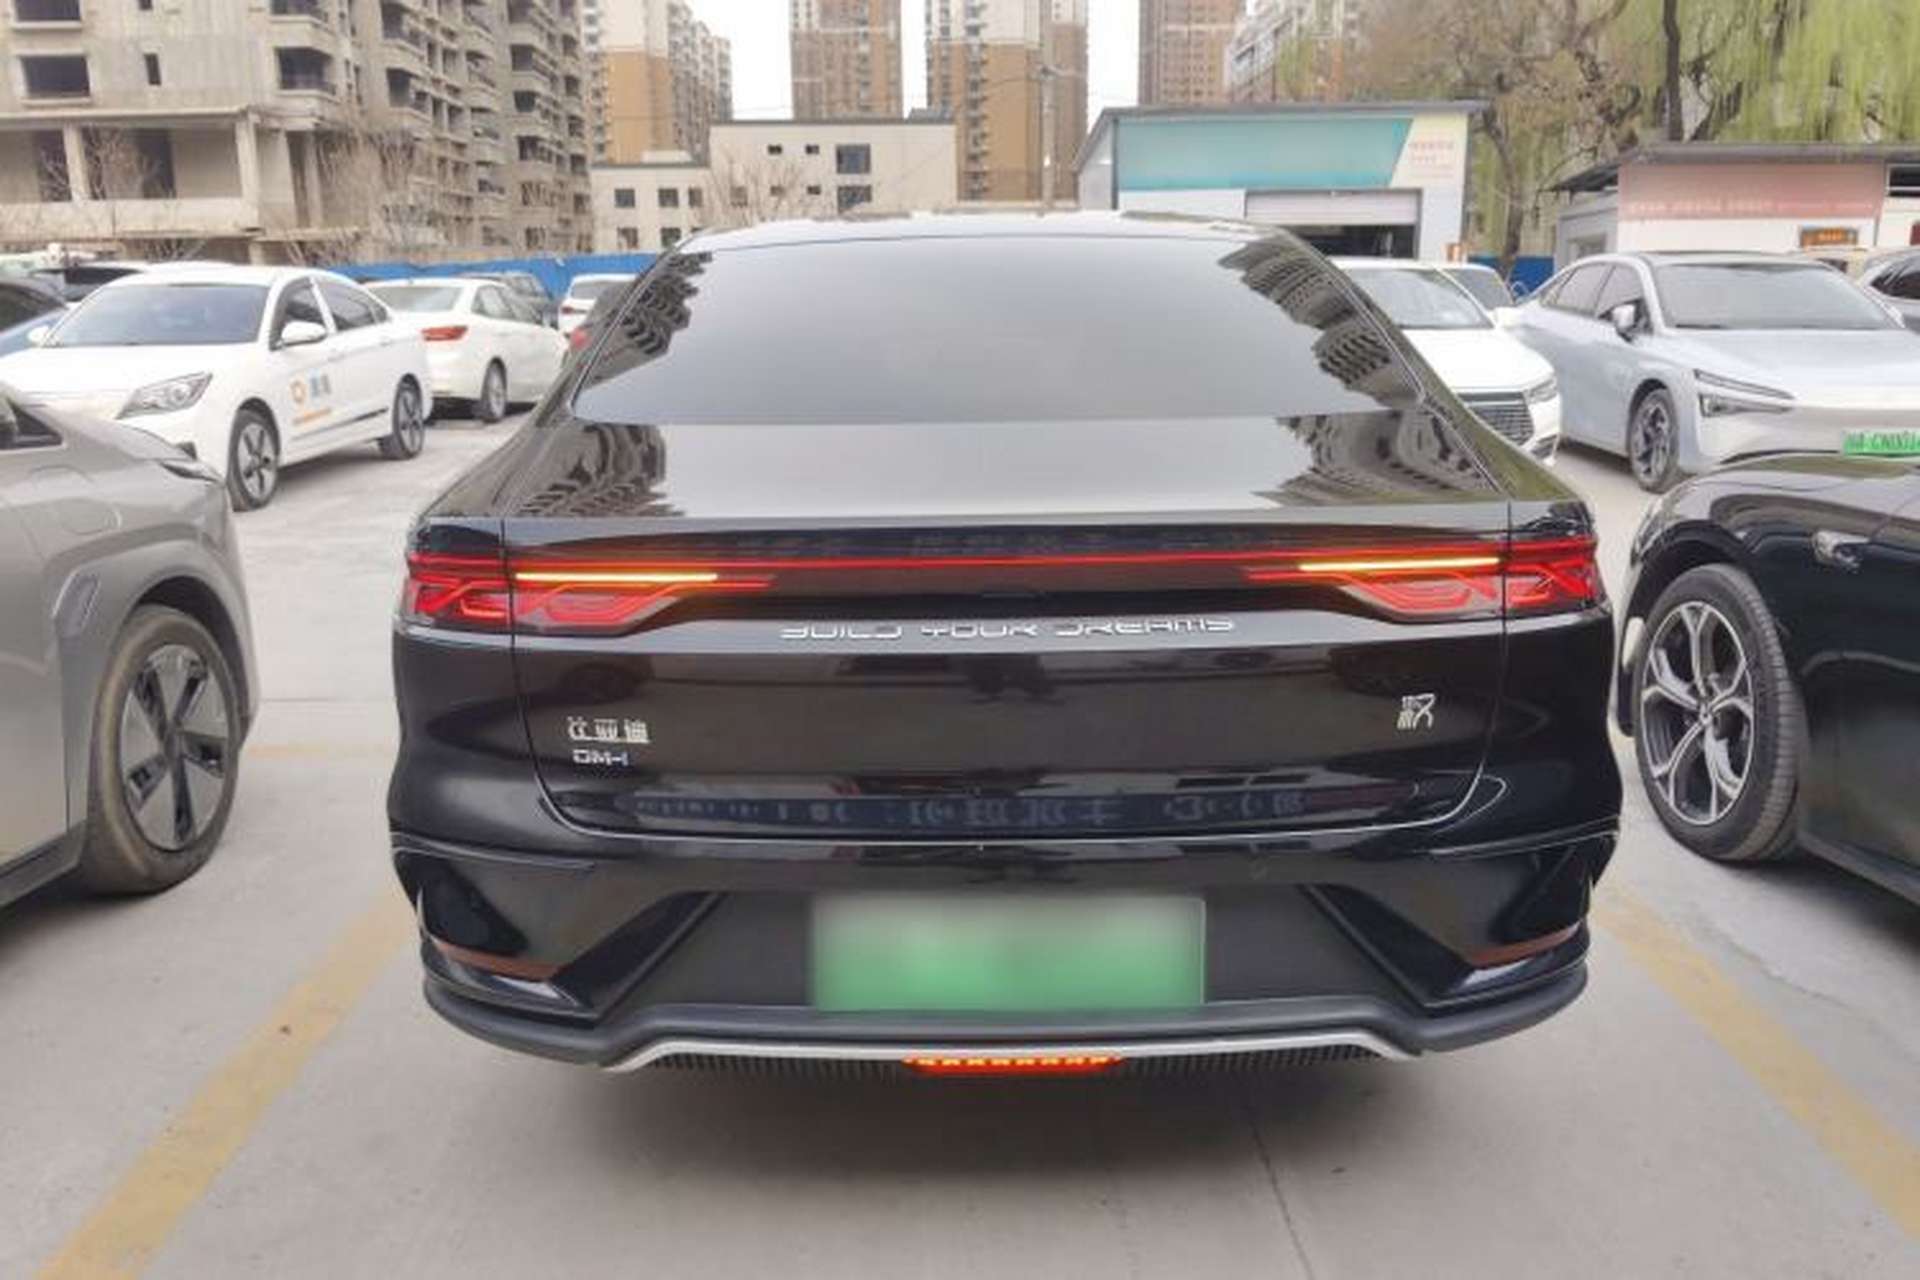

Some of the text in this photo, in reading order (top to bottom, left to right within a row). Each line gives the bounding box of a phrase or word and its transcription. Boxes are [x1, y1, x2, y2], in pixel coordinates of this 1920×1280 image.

[780, 618, 1235, 639] BUILD YOUR DREAMS
